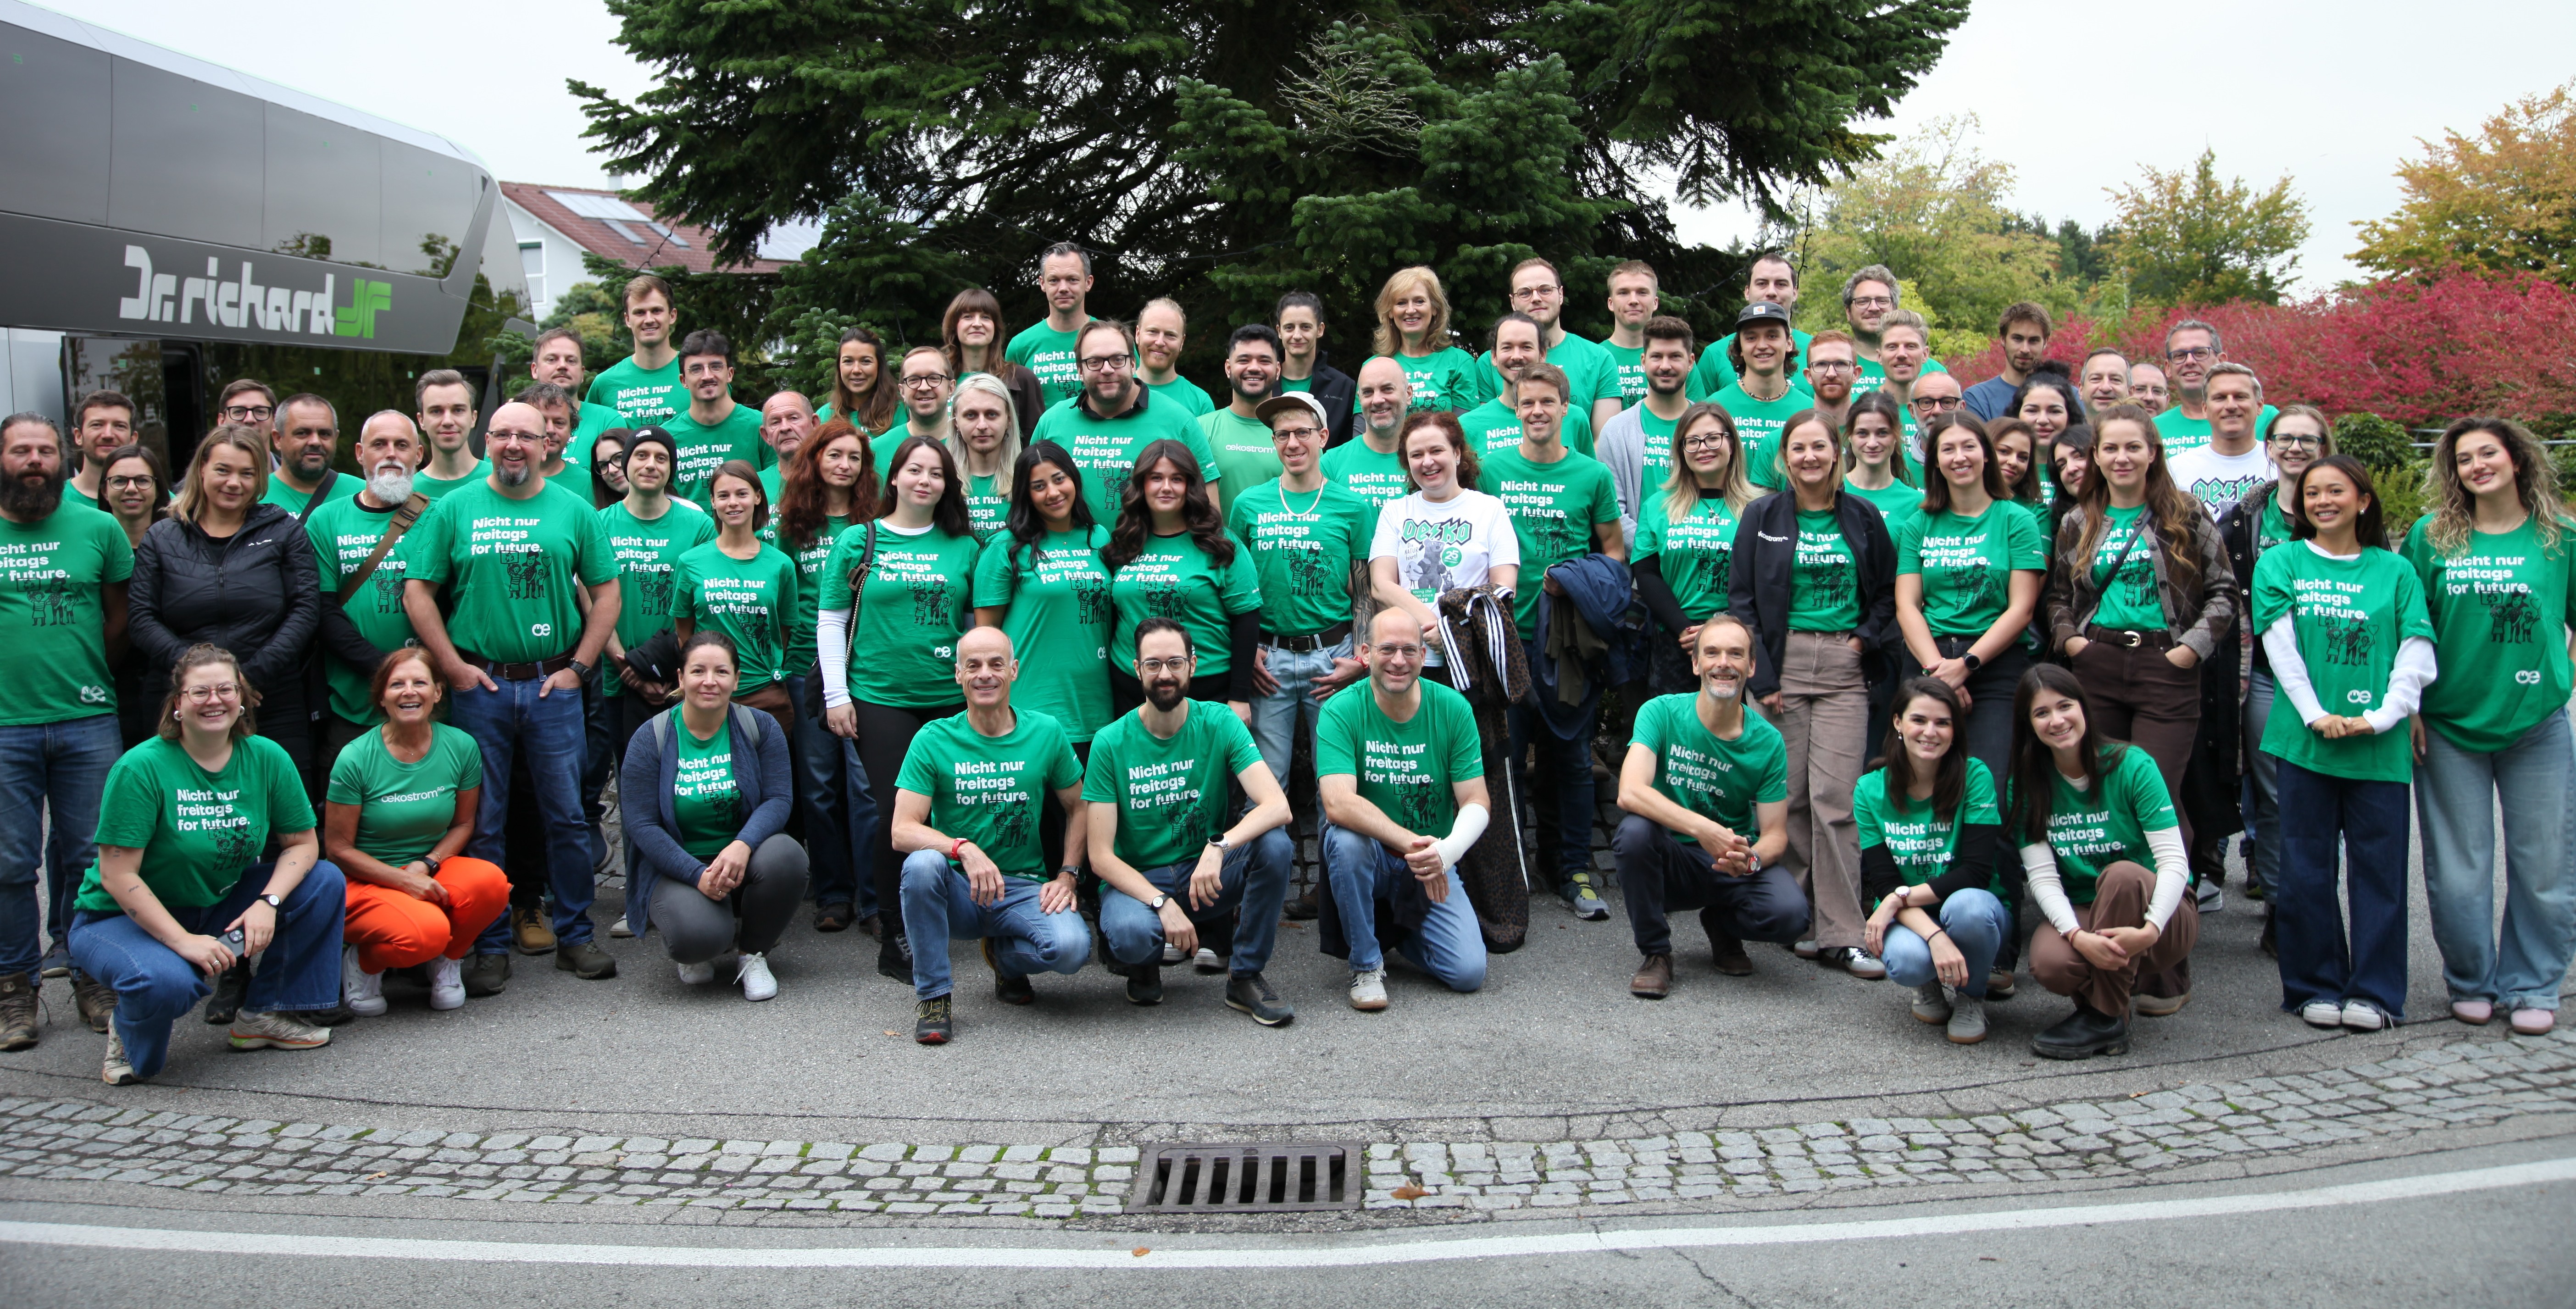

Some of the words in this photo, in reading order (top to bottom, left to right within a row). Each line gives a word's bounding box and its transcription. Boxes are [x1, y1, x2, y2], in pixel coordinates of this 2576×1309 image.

[119, 244, 177, 322] Dr.
[180, 256, 334, 335] richard
[1034, 351, 1066, 363] Nicht
[1038, 376, 1049, 385] or
[1414, 371, 1433, 380] nur
[617, 387, 650, 399] Nicht
[652, 385, 673, 394] nur
[616, 397, 664, 410] freitags
[636, 407, 677, 417] future.
[1765, 420, 1787, 428] nur
[1486, 426, 1520, 439] Nicht
[1075, 435, 1109, 445] Nicht
[2162, 435, 2196, 446] Nicht
[676, 444, 709, 459] Nicht
[711, 444, 732, 453] nur
[1072, 446, 1122, 459] freitags
[677, 456, 724, 471] freitags
[1093, 459, 1134, 469] future.
[678, 472, 696, 483] for
[1349, 472, 1385, 484] Nicht
[1501, 480, 1538, 492] Nicht
[1541, 483, 1566, 493] nur
[983, 496, 1004, 505] nur
[1500, 493, 1554, 507] freitags
[1258, 511, 1294, 524] Nicht
[1297, 513, 1321, 522] nur
[1507, 506, 1519, 516] or
[1522, 505, 1567, 519] future.
[472, 516, 511, 530] Nicht
[1707, 515, 1731, 526] nur
[471, 528, 528, 542] freitags
[763, 529, 775, 539] fo
[1257, 524, 1310, 538] freitags
[1667, 525, 1720, 538] freitags
[1816, 533, 1840, 542] nur
[337, 534, 377, 547] Nicht
[610, 536, 643, 547] Nicht
[645, 538, 669, 547] nur
[1257, 539, 1275, 551] for
[1278, 538, 1323, 550] future.
[1666, 539, 1684, 550] for
[1687, 537, 1732, 551] future.
[1922, 536, 1961, 548] Nicht
[1965, 532, 1987, 546] nur
[0, 544, 27, 555] cht
[31, 542, 61, 552] nur
[471, 544, 491, 555] for
[494, 542, 543, 554] future.
[1444, 549, 1460, 560] 25
[1920, 547, 1976, 561] freitags
[878, 551, 915, 561] Nicht
[1798, 552, 1849, 564] future.
[1923, 558, 1938, 568] or
[1941, 555, 1991, 566] future.
[2445, 555, 2491, 567] Nicht
[2495, 556, 2525, 566] nur
[341, 563, 360, 574] for
[629, 561, 674, 572] future.
[802, 563, 818, 574] for
[880, 561, 932, 572] freitags
[1038, 559, 1089, 572] freitags
[1121, 563, 1169, 573] freitags
[9, 569, 71, 582] future.
[878, 571, 899, 582] for
[901, 571, 948, 582] future.
[1040, 573, 1061, 584] for
[1064, 570, 1105, 580] future.
[1115, 574, 1133, 582] for
[1136, 572, 1180, 582] future.
[2446, 567, 2513, 581] freitags
[704, 577, 740, 589] Nicht
[743, 580, 766, 588] nur
[2293, 578, 2332, 590] Nicht
[2336, 582, 2364, 593] nur
[2446, 583, 2469, 595] for
[2473, 581, 2532, 593] future.
[705, 589, 757, 603] freitags
[2296, 591, 2351, 606] reitags
[708, 604, 726, 614] for
[2297, 606, 2310, 616] or
[2313, 604, 2369, 620] future.
[1366, 740, 1399, 754] Nicht
[1402, 743, 1426, 755] nur
[677, 758, 709, 770] Nicht
[1365, 755, 1417, 772] freitags
[1670, 743, 1705, 762] Nicht
[1708, 757, 1732, 772] nur
[955, 761, 996, 775] Nicht
[1000, 761, 1025, 772] nur
[1129, 763, 1168, 780] Nicht
[1171, 759, 1194, 772] nur
[1667, 759, 1717, 780] freitags
[676, 768, 727, 782] freitags
[1364, 770, 1386, 783] for
[1389, 772, 1433, 784] future.
[955, 776, 1016, 790] freitags
[1129, 775, 1186, 796] freitags
[1666, 773, 1685, 786] for
[1686, 777, 1726, 798] future.
[177, 789, 213, 801] Nicht
[217, 789, 239, 801] nur
[674, 784, 694, 796] for
[956, 793, 977, 805] for
[981, 791, 1030, 804] future.
[1130, 797, 1152, 810] for
[1155, 789, 1201, 806] future.
[177, 804, 233, 817] freitags
[2086, 810, 2109, 823] nur
[178, 819, 199, 831] for
[201, 816, 250, 830] future.
[1884, 821, 1926, 835] Nicht
[1929, 822, 1952, 832] nur
[2047, 828, 2105, 842] freitags
[1885, 836, 1943, 851] freitags
[2057, 846, 2071, 856] or
[2072, 841, 2126, 855] future.
[1893, 855, 1907, 865] or
[1911, 851, 1955, 865] future.
